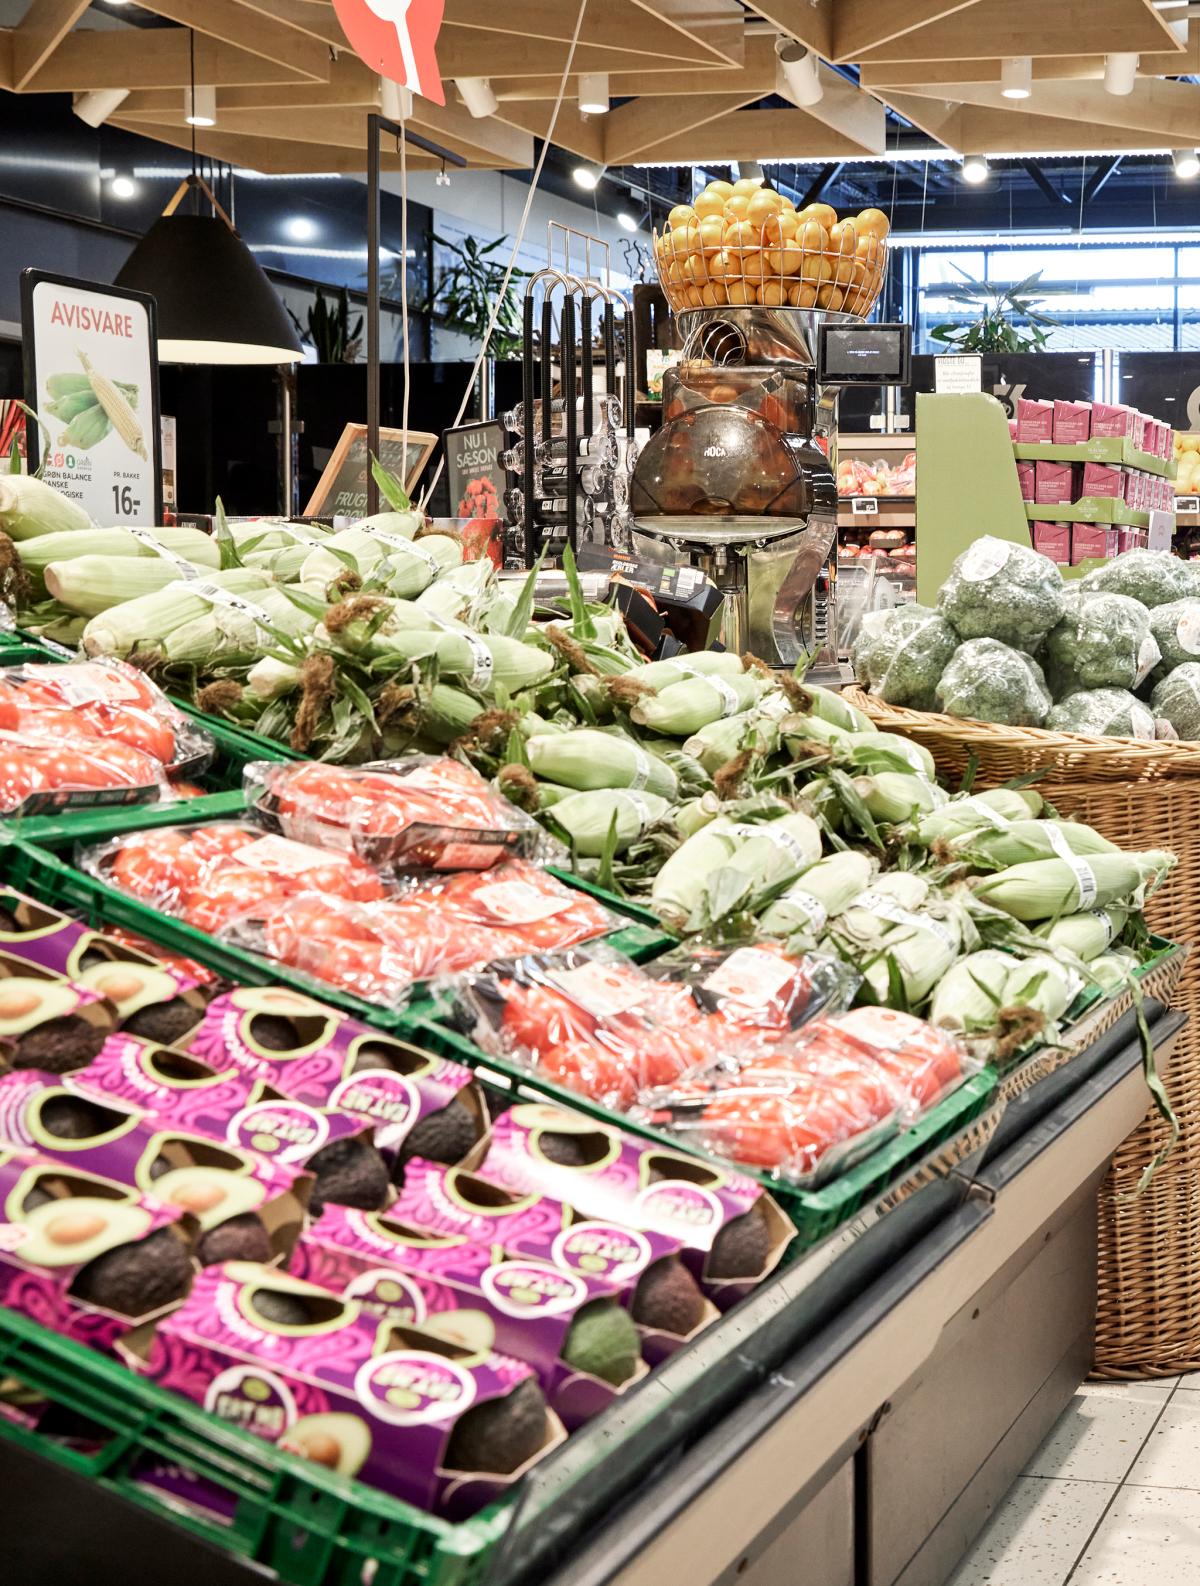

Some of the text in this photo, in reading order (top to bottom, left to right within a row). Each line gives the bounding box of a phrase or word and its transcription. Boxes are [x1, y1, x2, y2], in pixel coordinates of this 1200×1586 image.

[51, 301, 133, 339] AVISVARE
[463, 431, 488, 450] NU I
[456, 447, 497, 468] SÆSON
[62, 471, 92, 482] BALANCE
[122, 472, 140, 480] BAKKE
